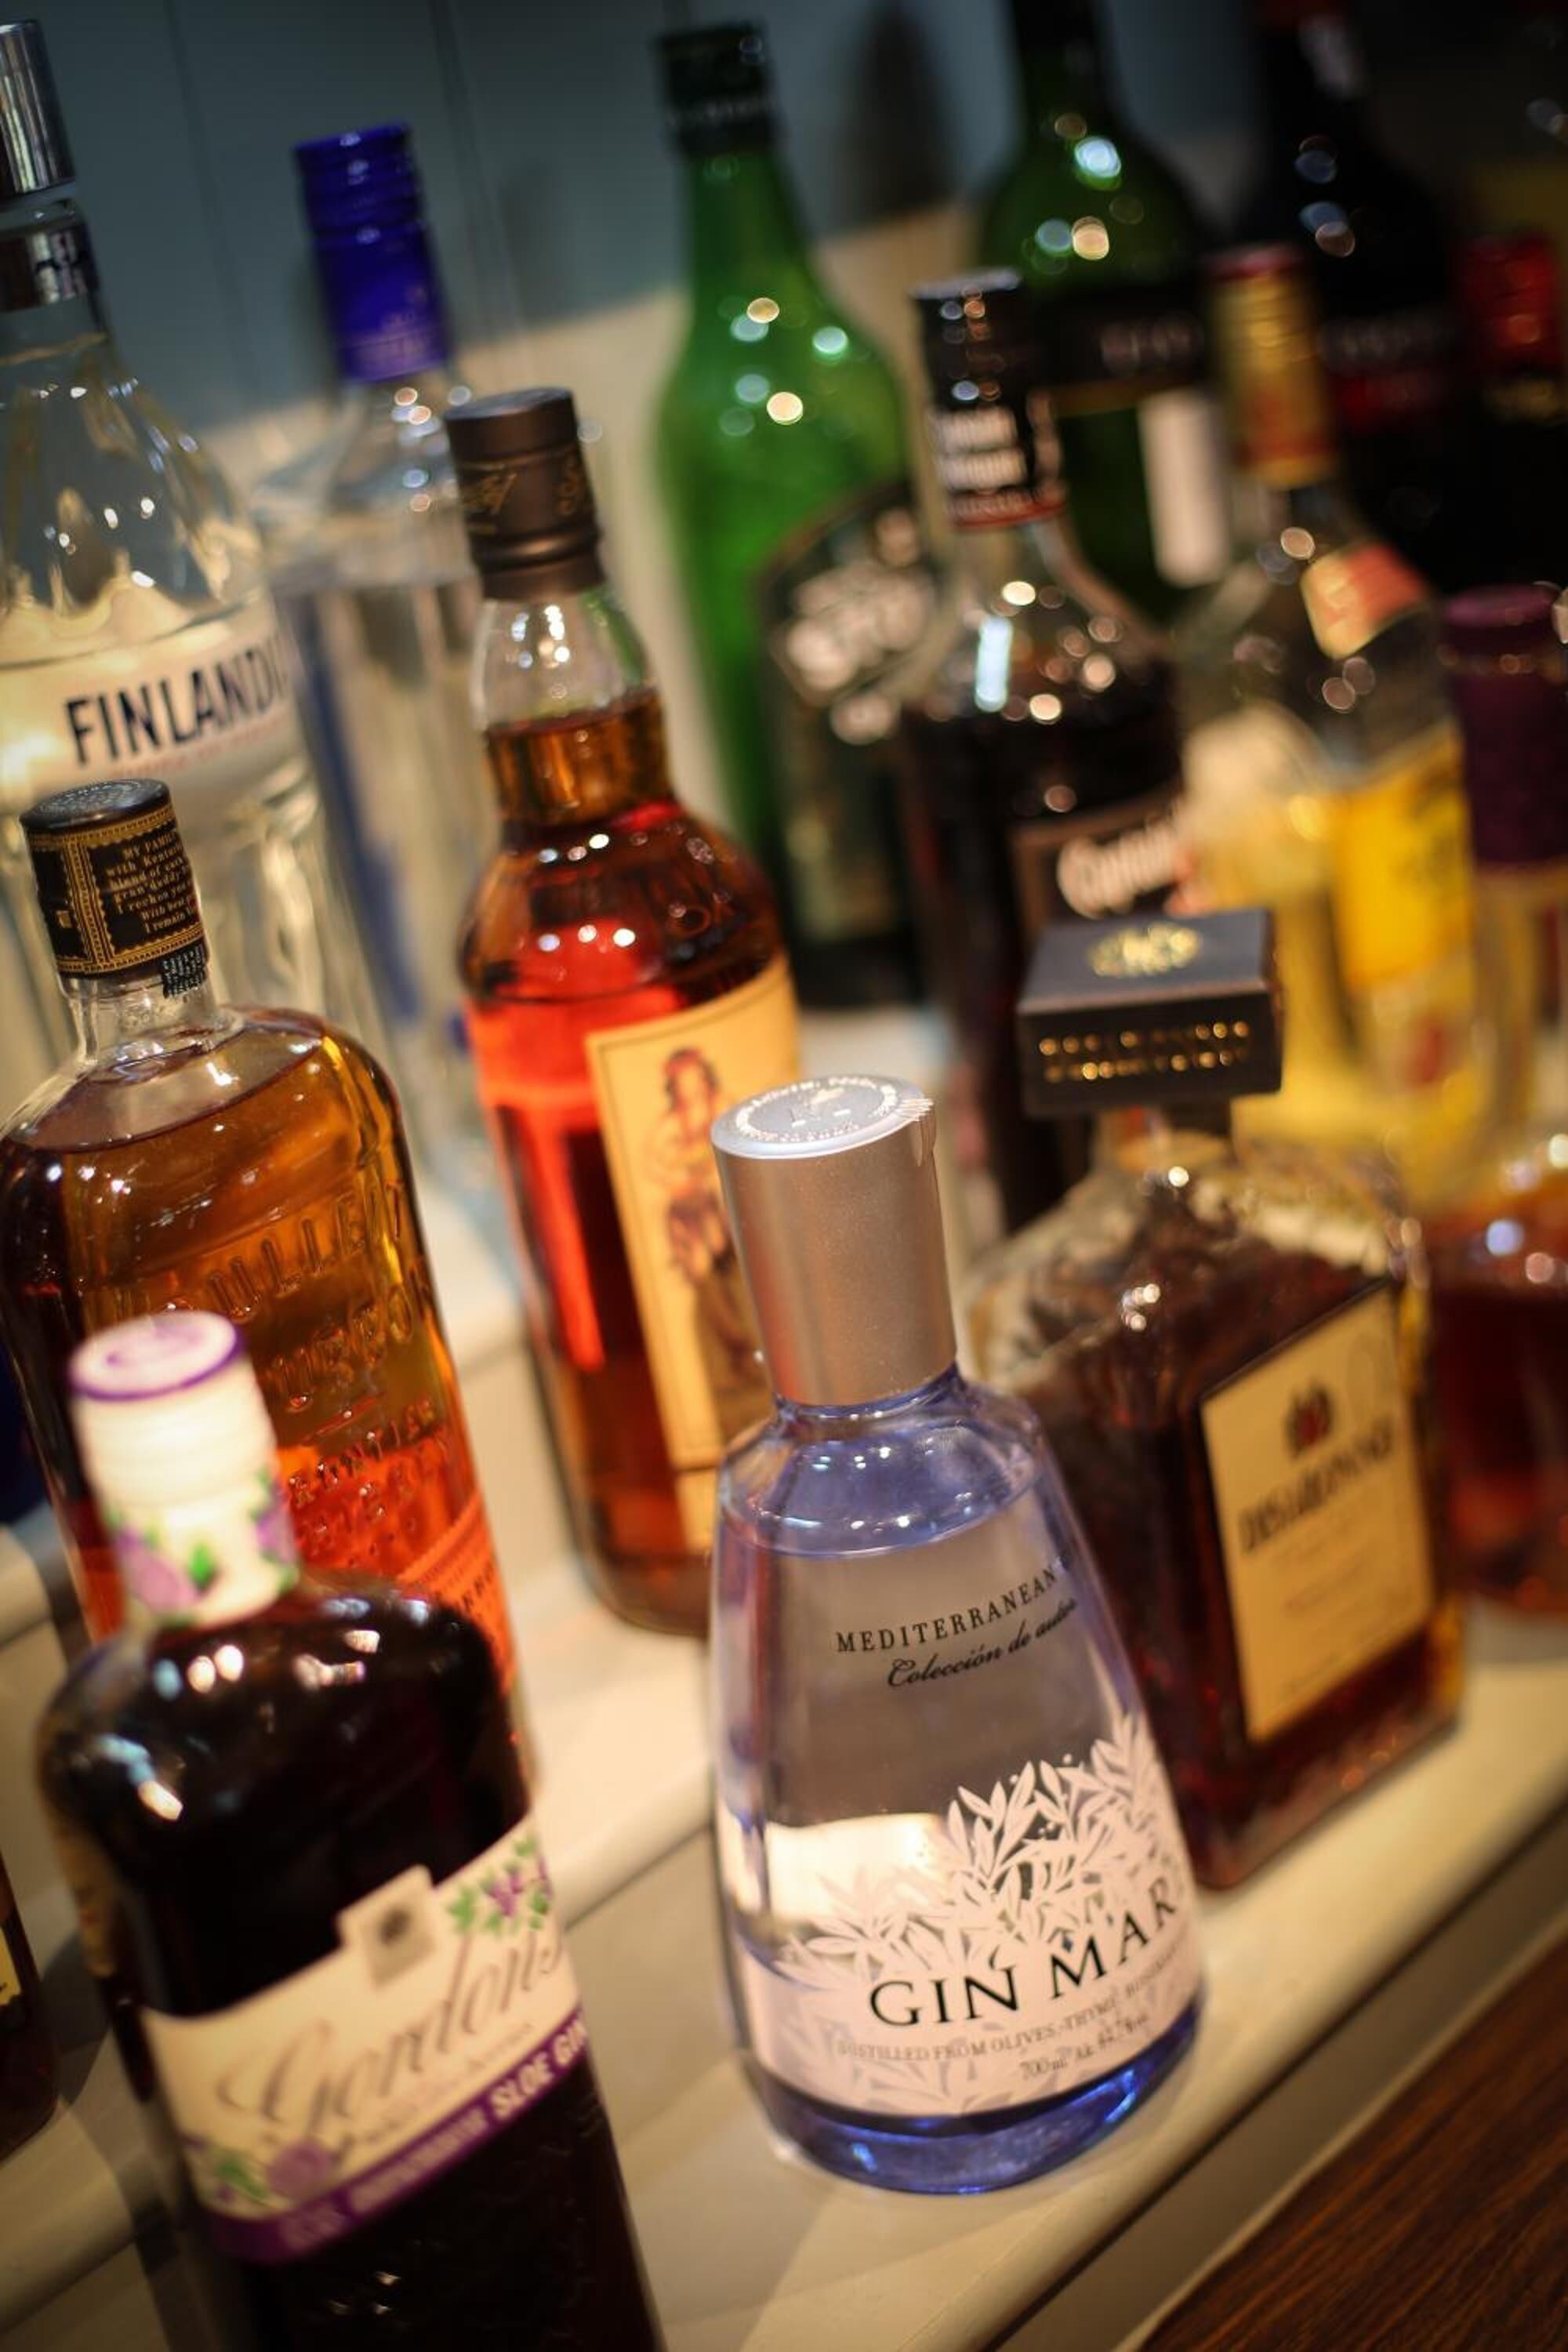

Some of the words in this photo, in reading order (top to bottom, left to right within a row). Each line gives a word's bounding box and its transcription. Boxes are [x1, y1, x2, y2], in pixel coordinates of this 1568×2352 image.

[836, 1564, 1056, 1653] MEDITERRANEAN
[1007, 1617, 1032, 1653] de
[869, 1965, 1020, 2027] GIN
[932, 2038, 988, 2060] FROM
